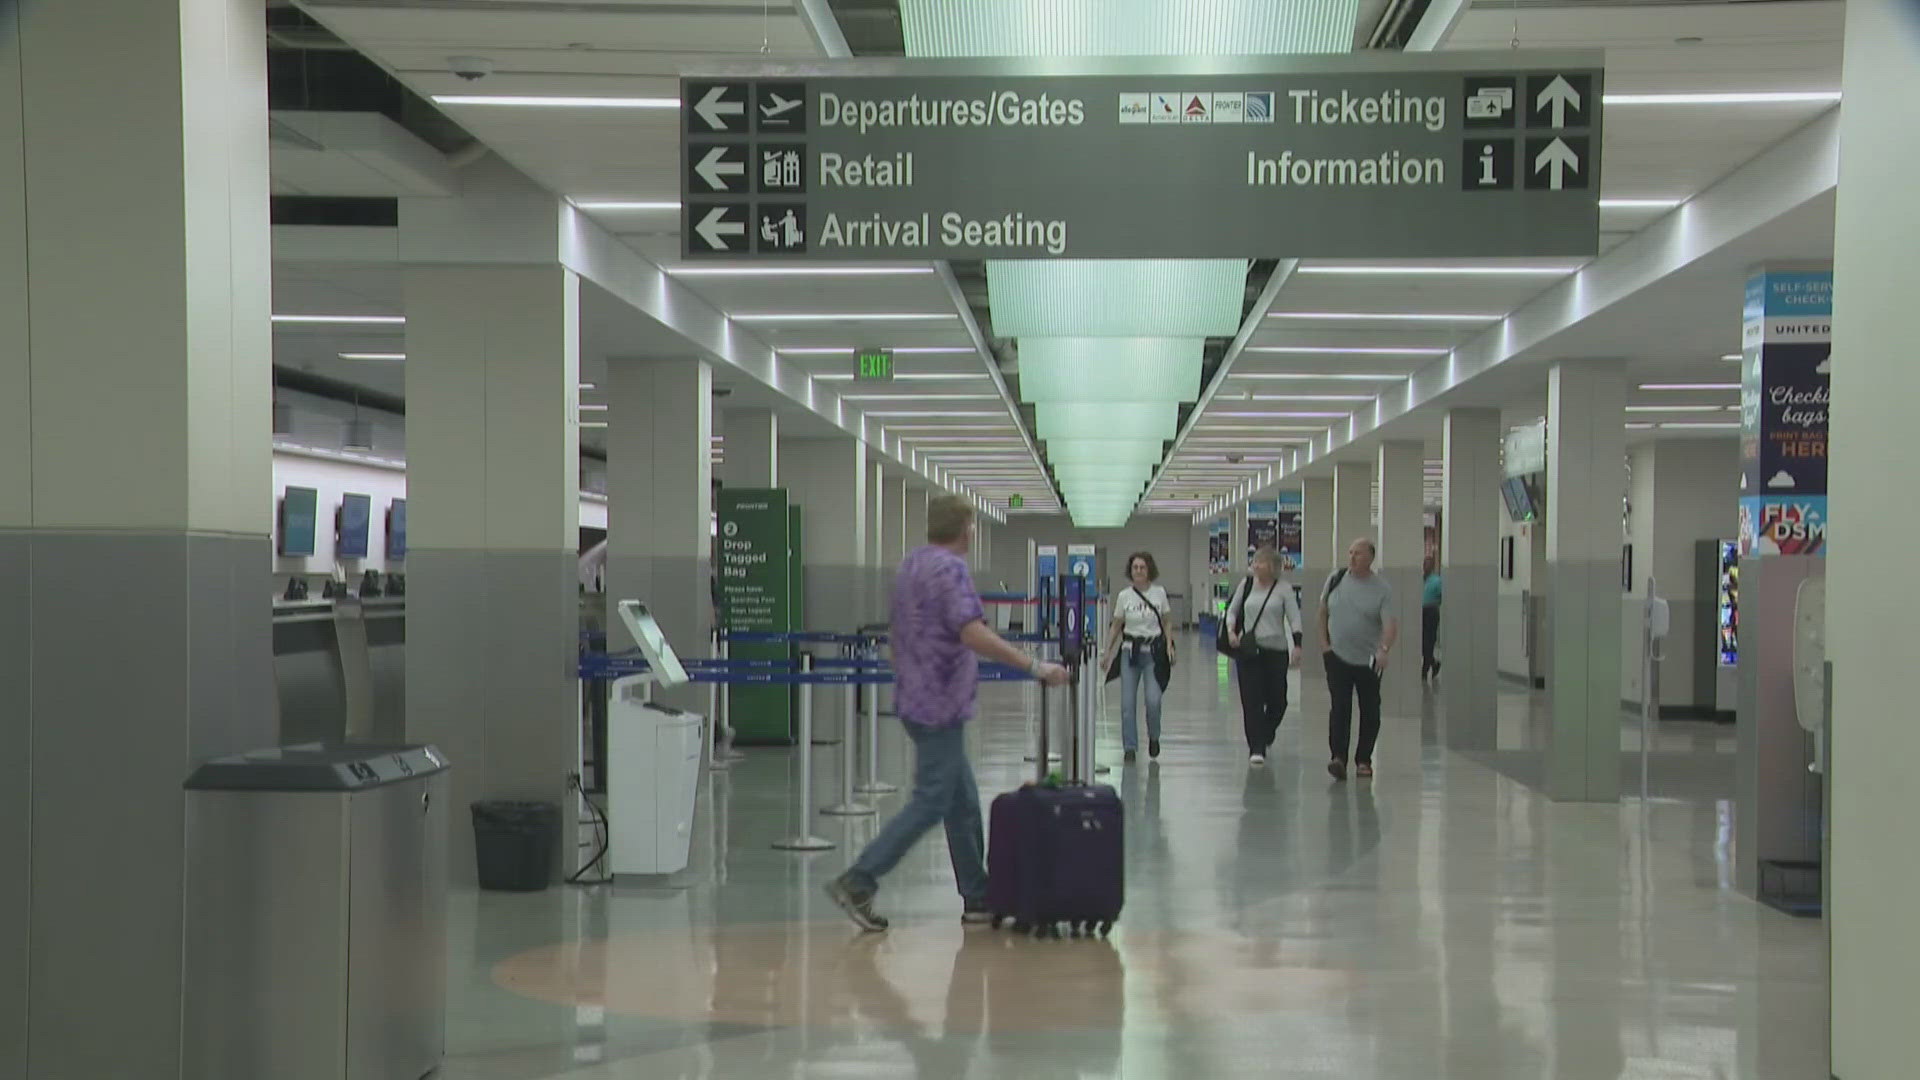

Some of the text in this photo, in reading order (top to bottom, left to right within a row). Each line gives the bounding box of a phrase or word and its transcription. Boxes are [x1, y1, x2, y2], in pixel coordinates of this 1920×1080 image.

[818, 91, 1085, 133] Departures/Gates
[1287, 89, 1446, 131] Ticketing
[819, 151, 914, 186] Retail
[1246, 151, 1446, 185] Information
[819, 212, 1067, 254] Arrival Seating
[1775, 325, 1831, 335] UNITED
[860, 354, 889, 377] EXIT
[1765, 503, 1811, 523] FLY
[1774, 522, 1827, 541] DSM
[723, 539, 752, 552] Drop
[724, 552, 767, 565] Tagged
[724, 566, 747, 579] Bag
